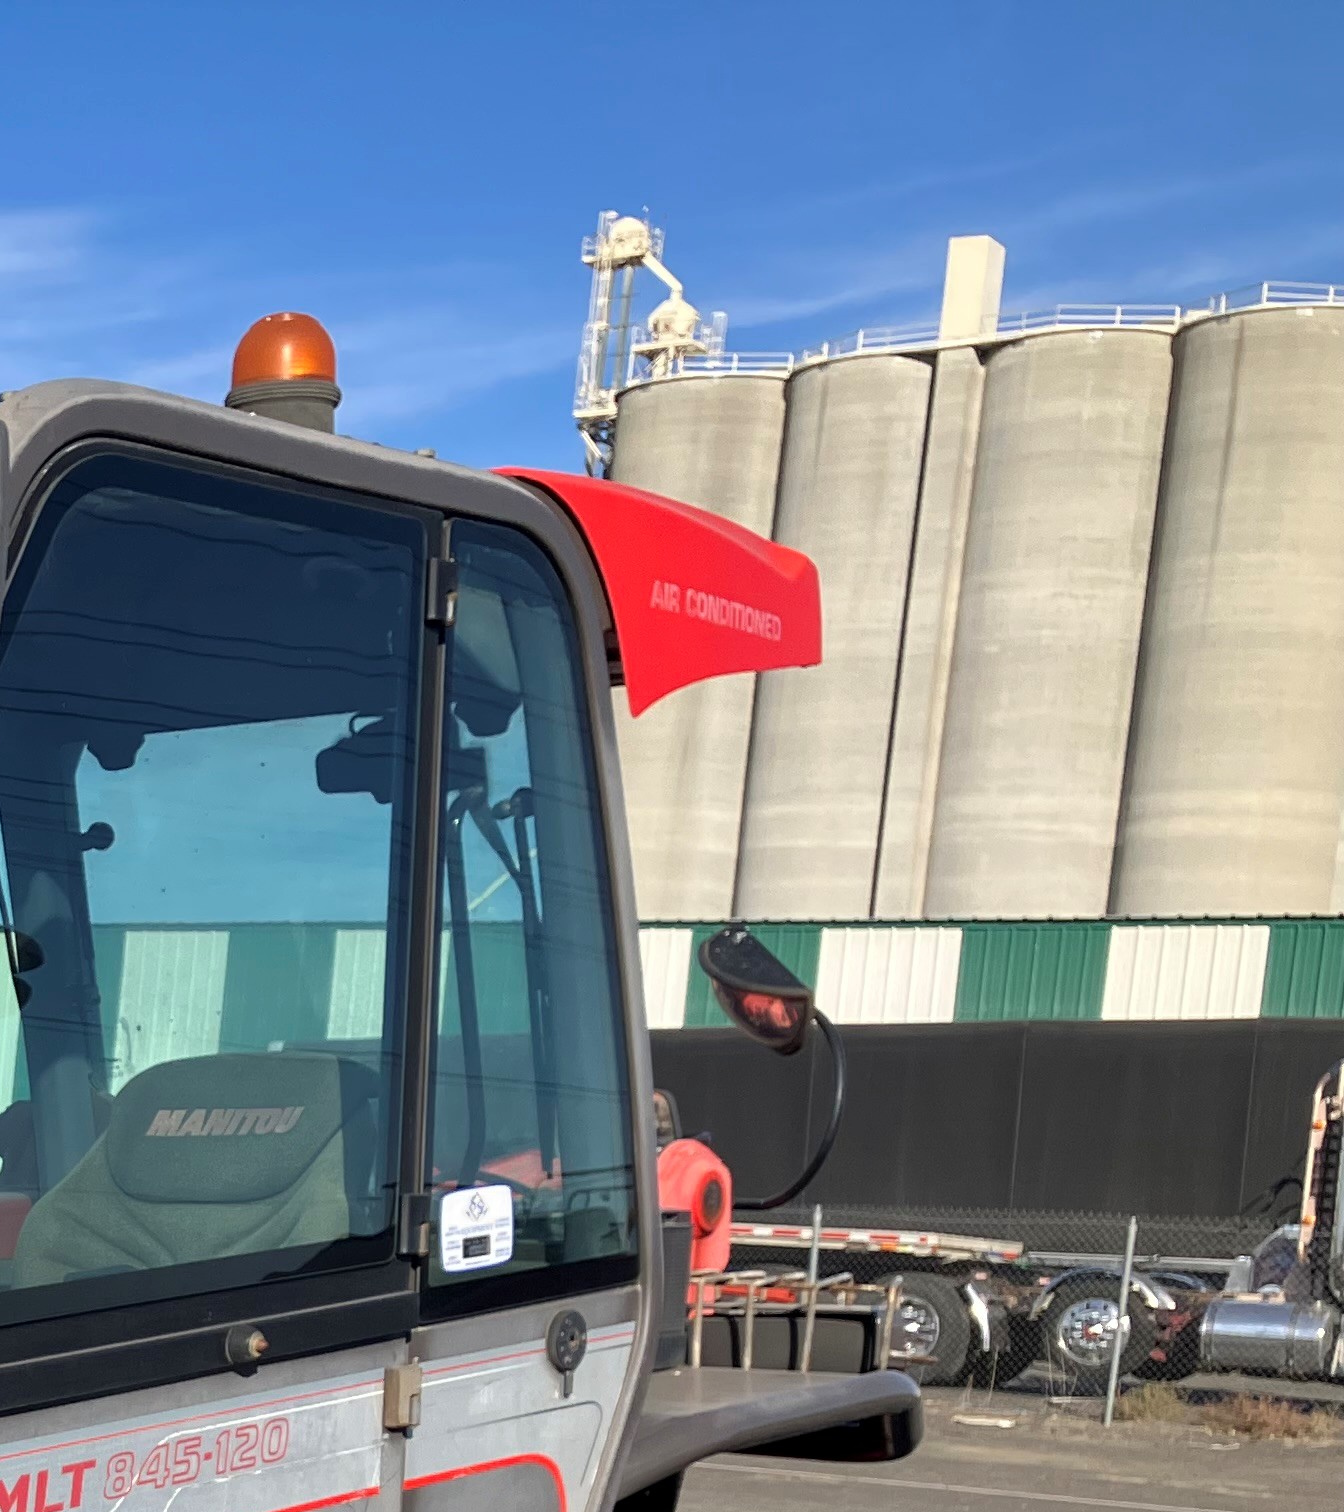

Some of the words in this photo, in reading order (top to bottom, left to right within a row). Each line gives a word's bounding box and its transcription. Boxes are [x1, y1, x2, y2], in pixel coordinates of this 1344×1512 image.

[649, 579, 681, 614] AIR
[684, 588, 782, 641] CONDITIONED
[145, 1105, 306, 1138] MANITOU
